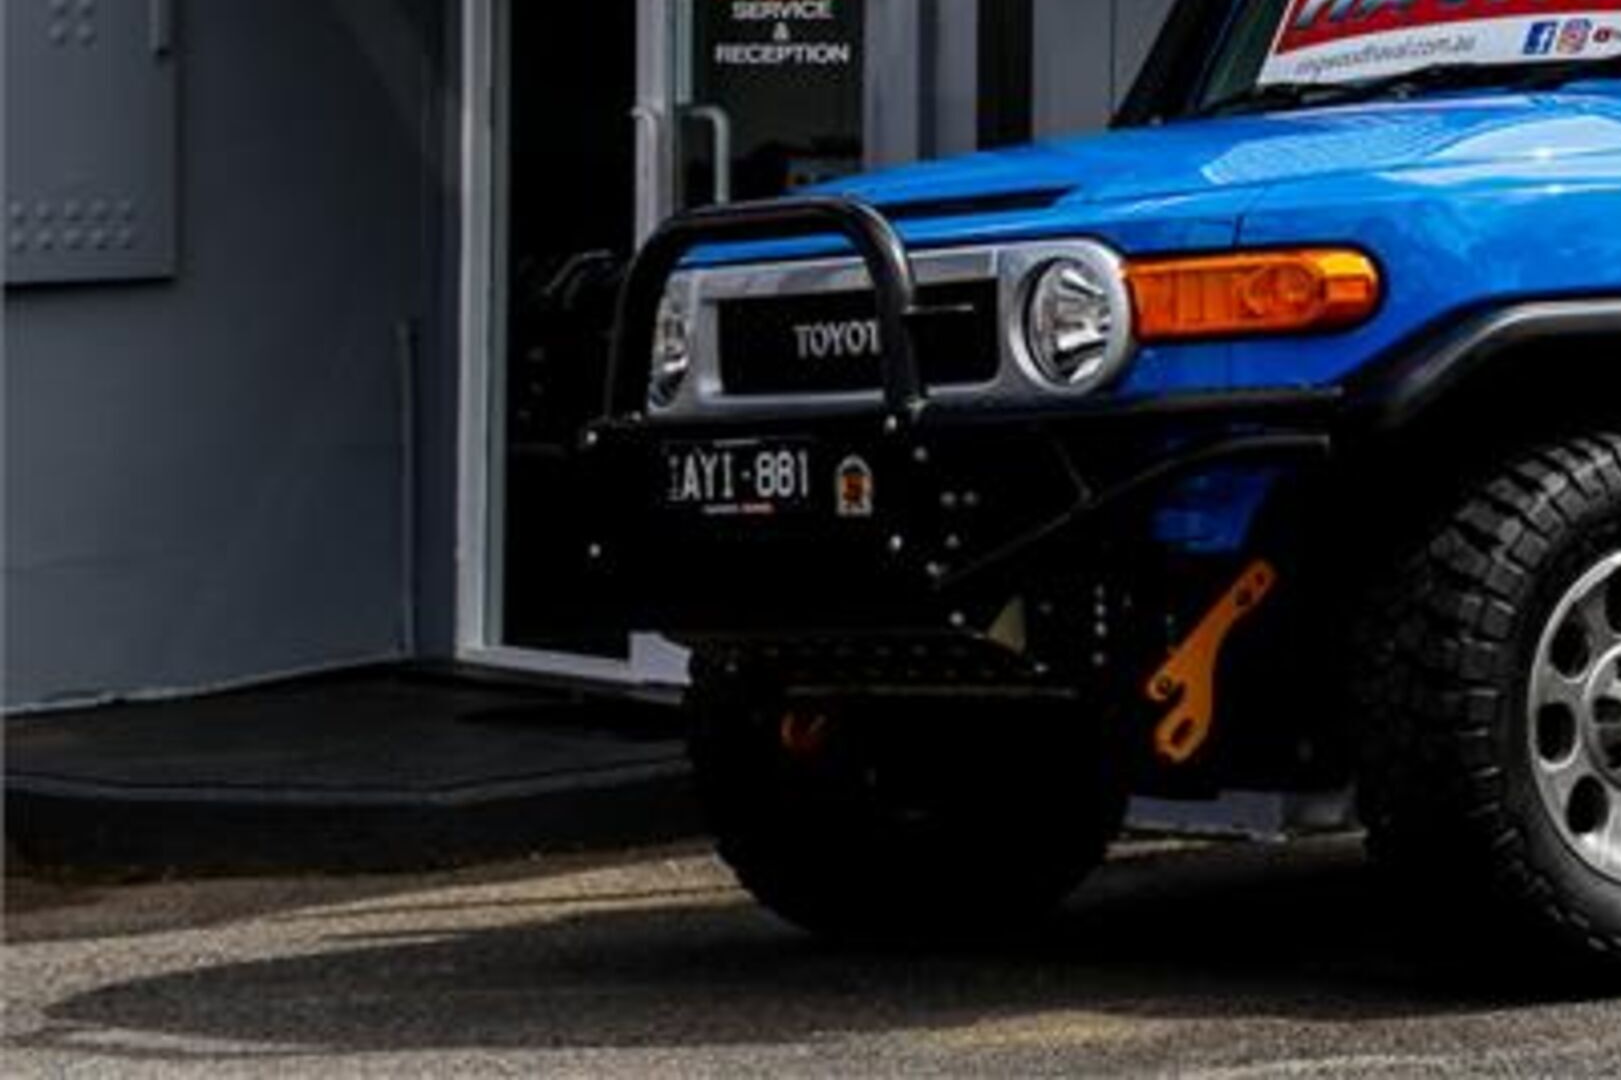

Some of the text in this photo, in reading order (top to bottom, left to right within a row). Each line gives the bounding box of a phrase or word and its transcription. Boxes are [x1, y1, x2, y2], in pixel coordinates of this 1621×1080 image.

[732, 0, 834, 20] SERVICE
[714, 43, 850, 64] RECEPTION
[794, 320, 882, 358] TOYOT
